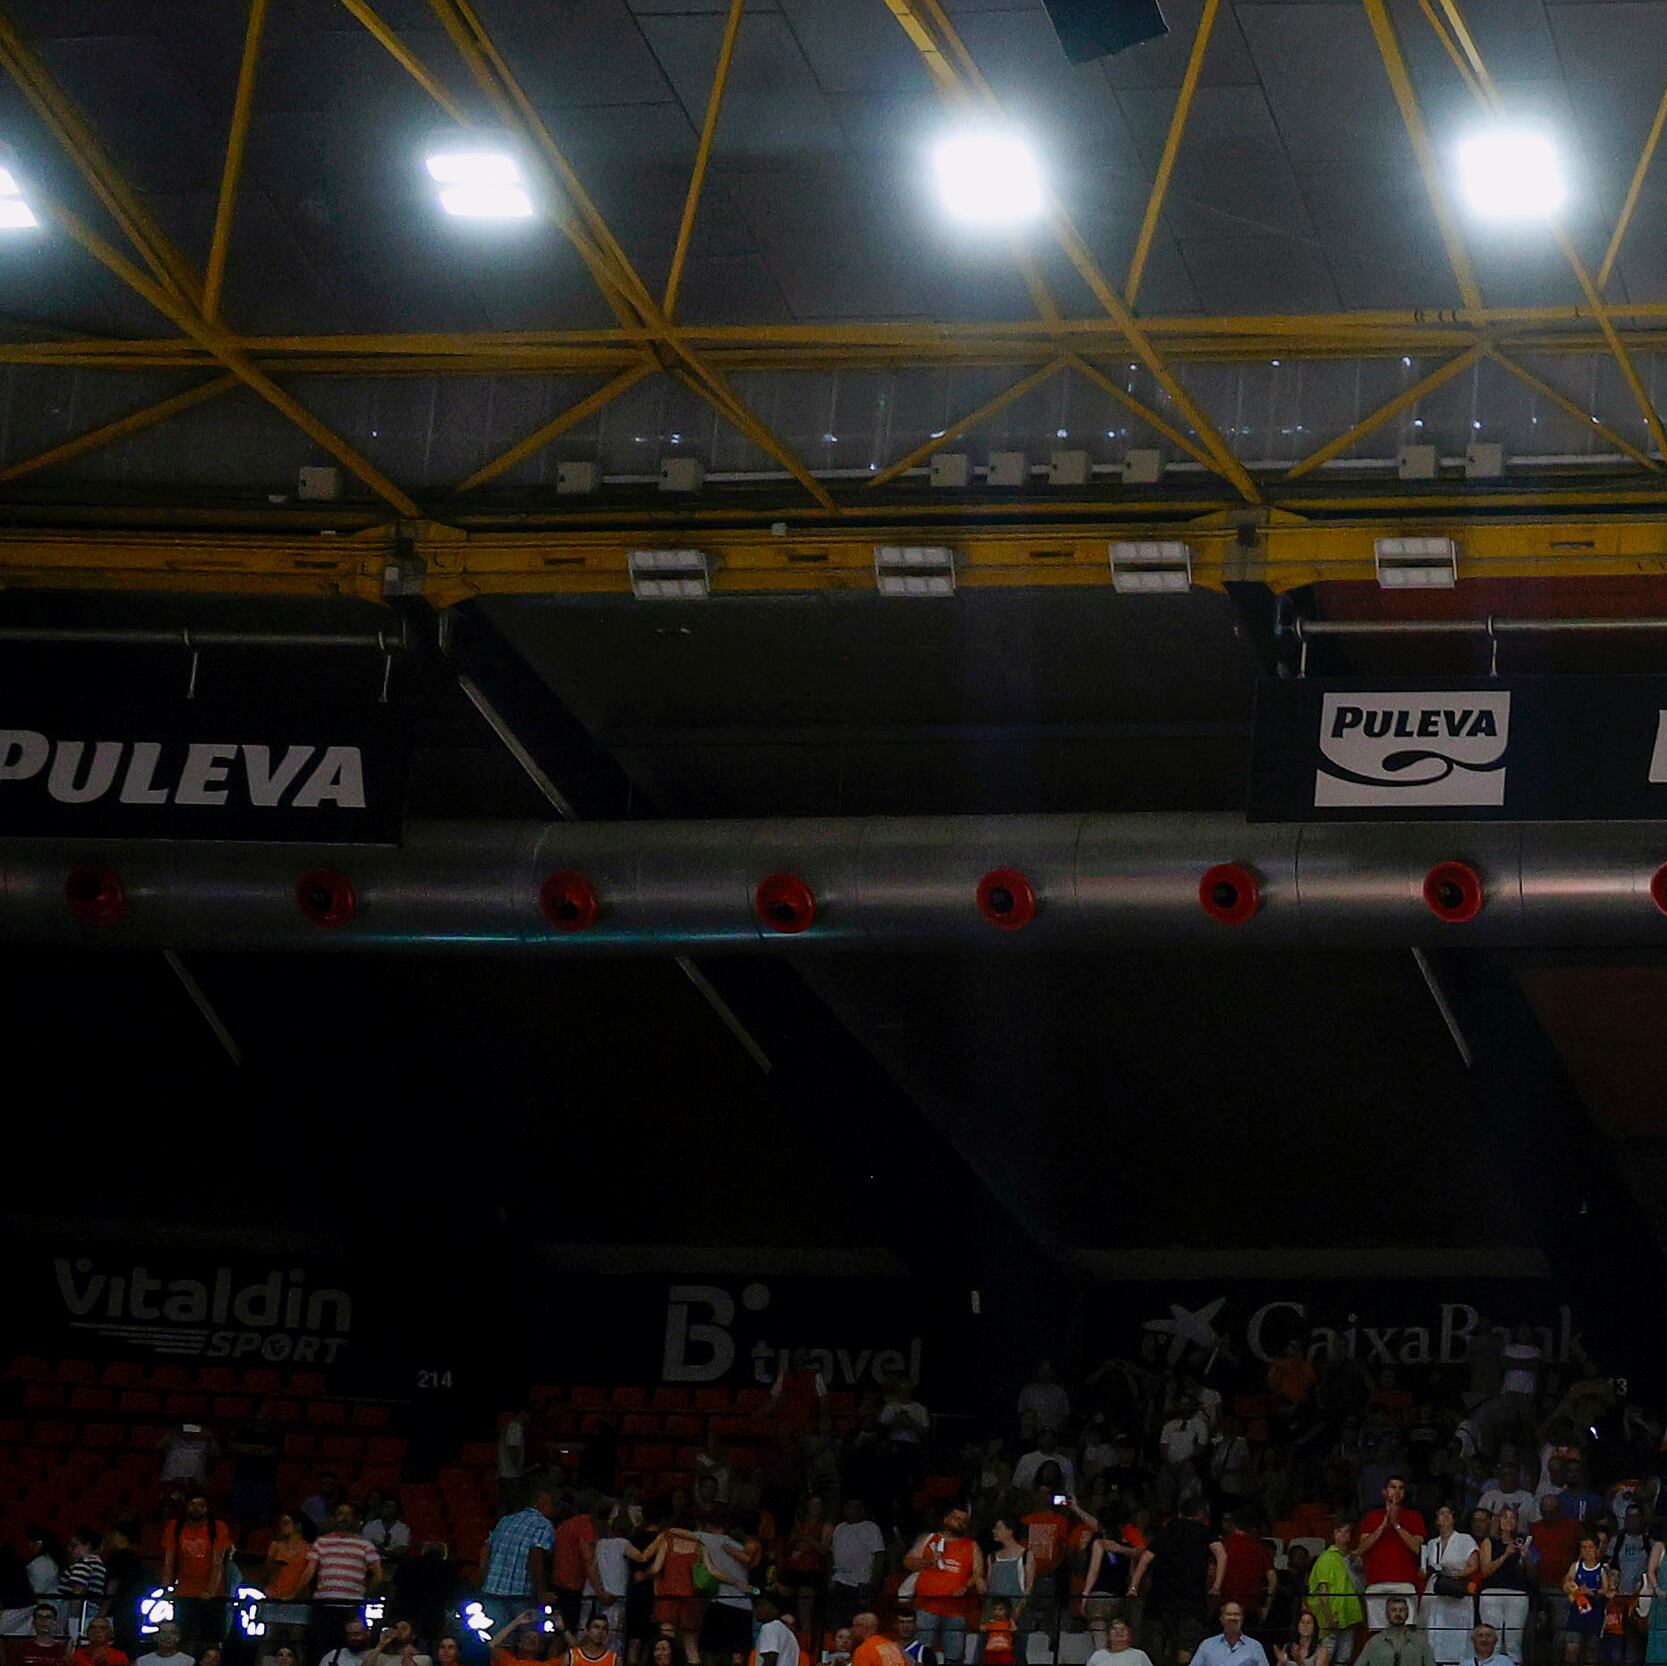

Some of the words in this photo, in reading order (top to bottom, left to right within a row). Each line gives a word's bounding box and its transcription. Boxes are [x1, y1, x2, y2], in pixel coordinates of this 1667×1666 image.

[1330, 705, 1498, 740] PULEVA
[0, 729, 366, 808] PULEVA
[52, 1256, 352, 1333] Vitaldin
[206, 1330, 351, 1364] SPORT
[415, 1368, 456, 1392] 214
